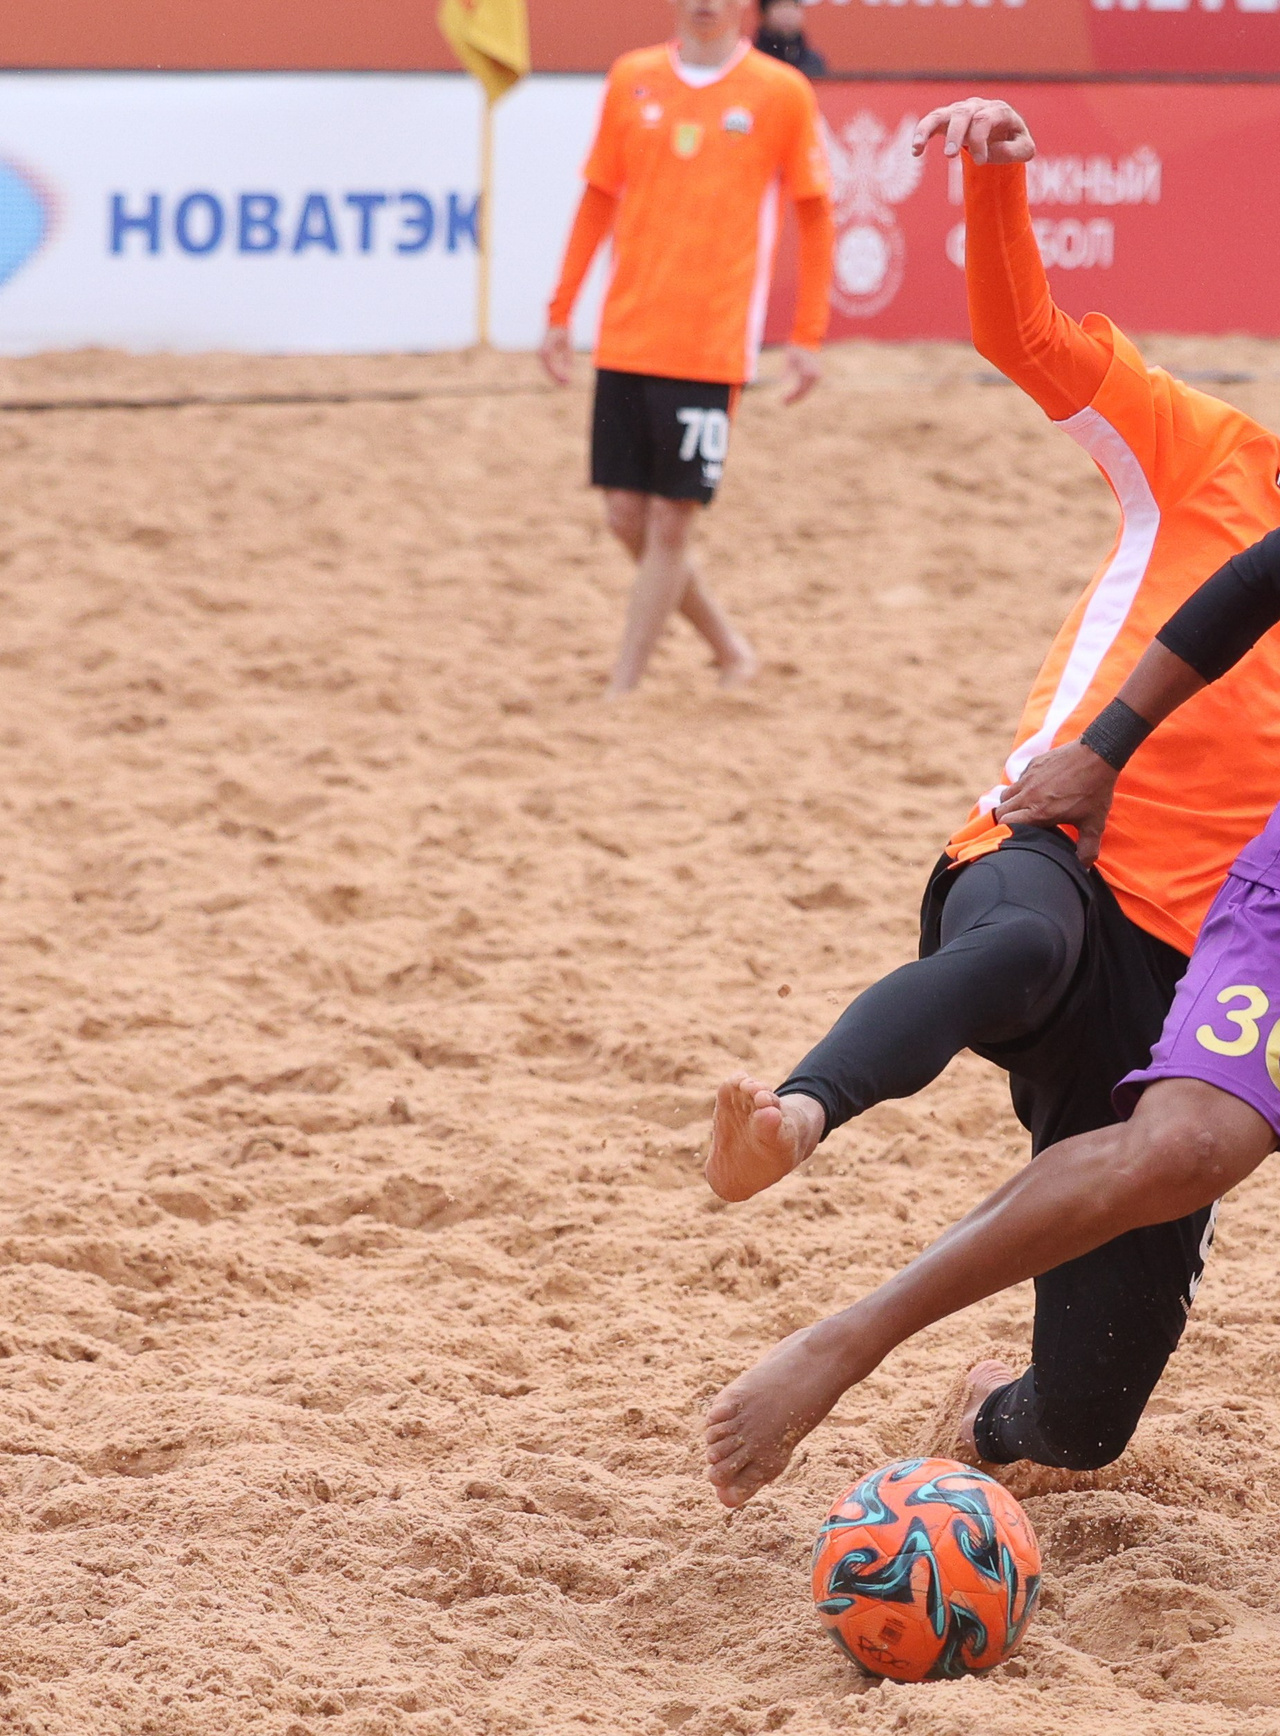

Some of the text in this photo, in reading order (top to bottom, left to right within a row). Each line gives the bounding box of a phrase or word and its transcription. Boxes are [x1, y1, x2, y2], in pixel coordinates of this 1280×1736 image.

[947, 147, 1162, 205] ЖНЫЙ
[109, 191, 483, 256] НОВАТЭК
[676, 407, 729, 462] 70
